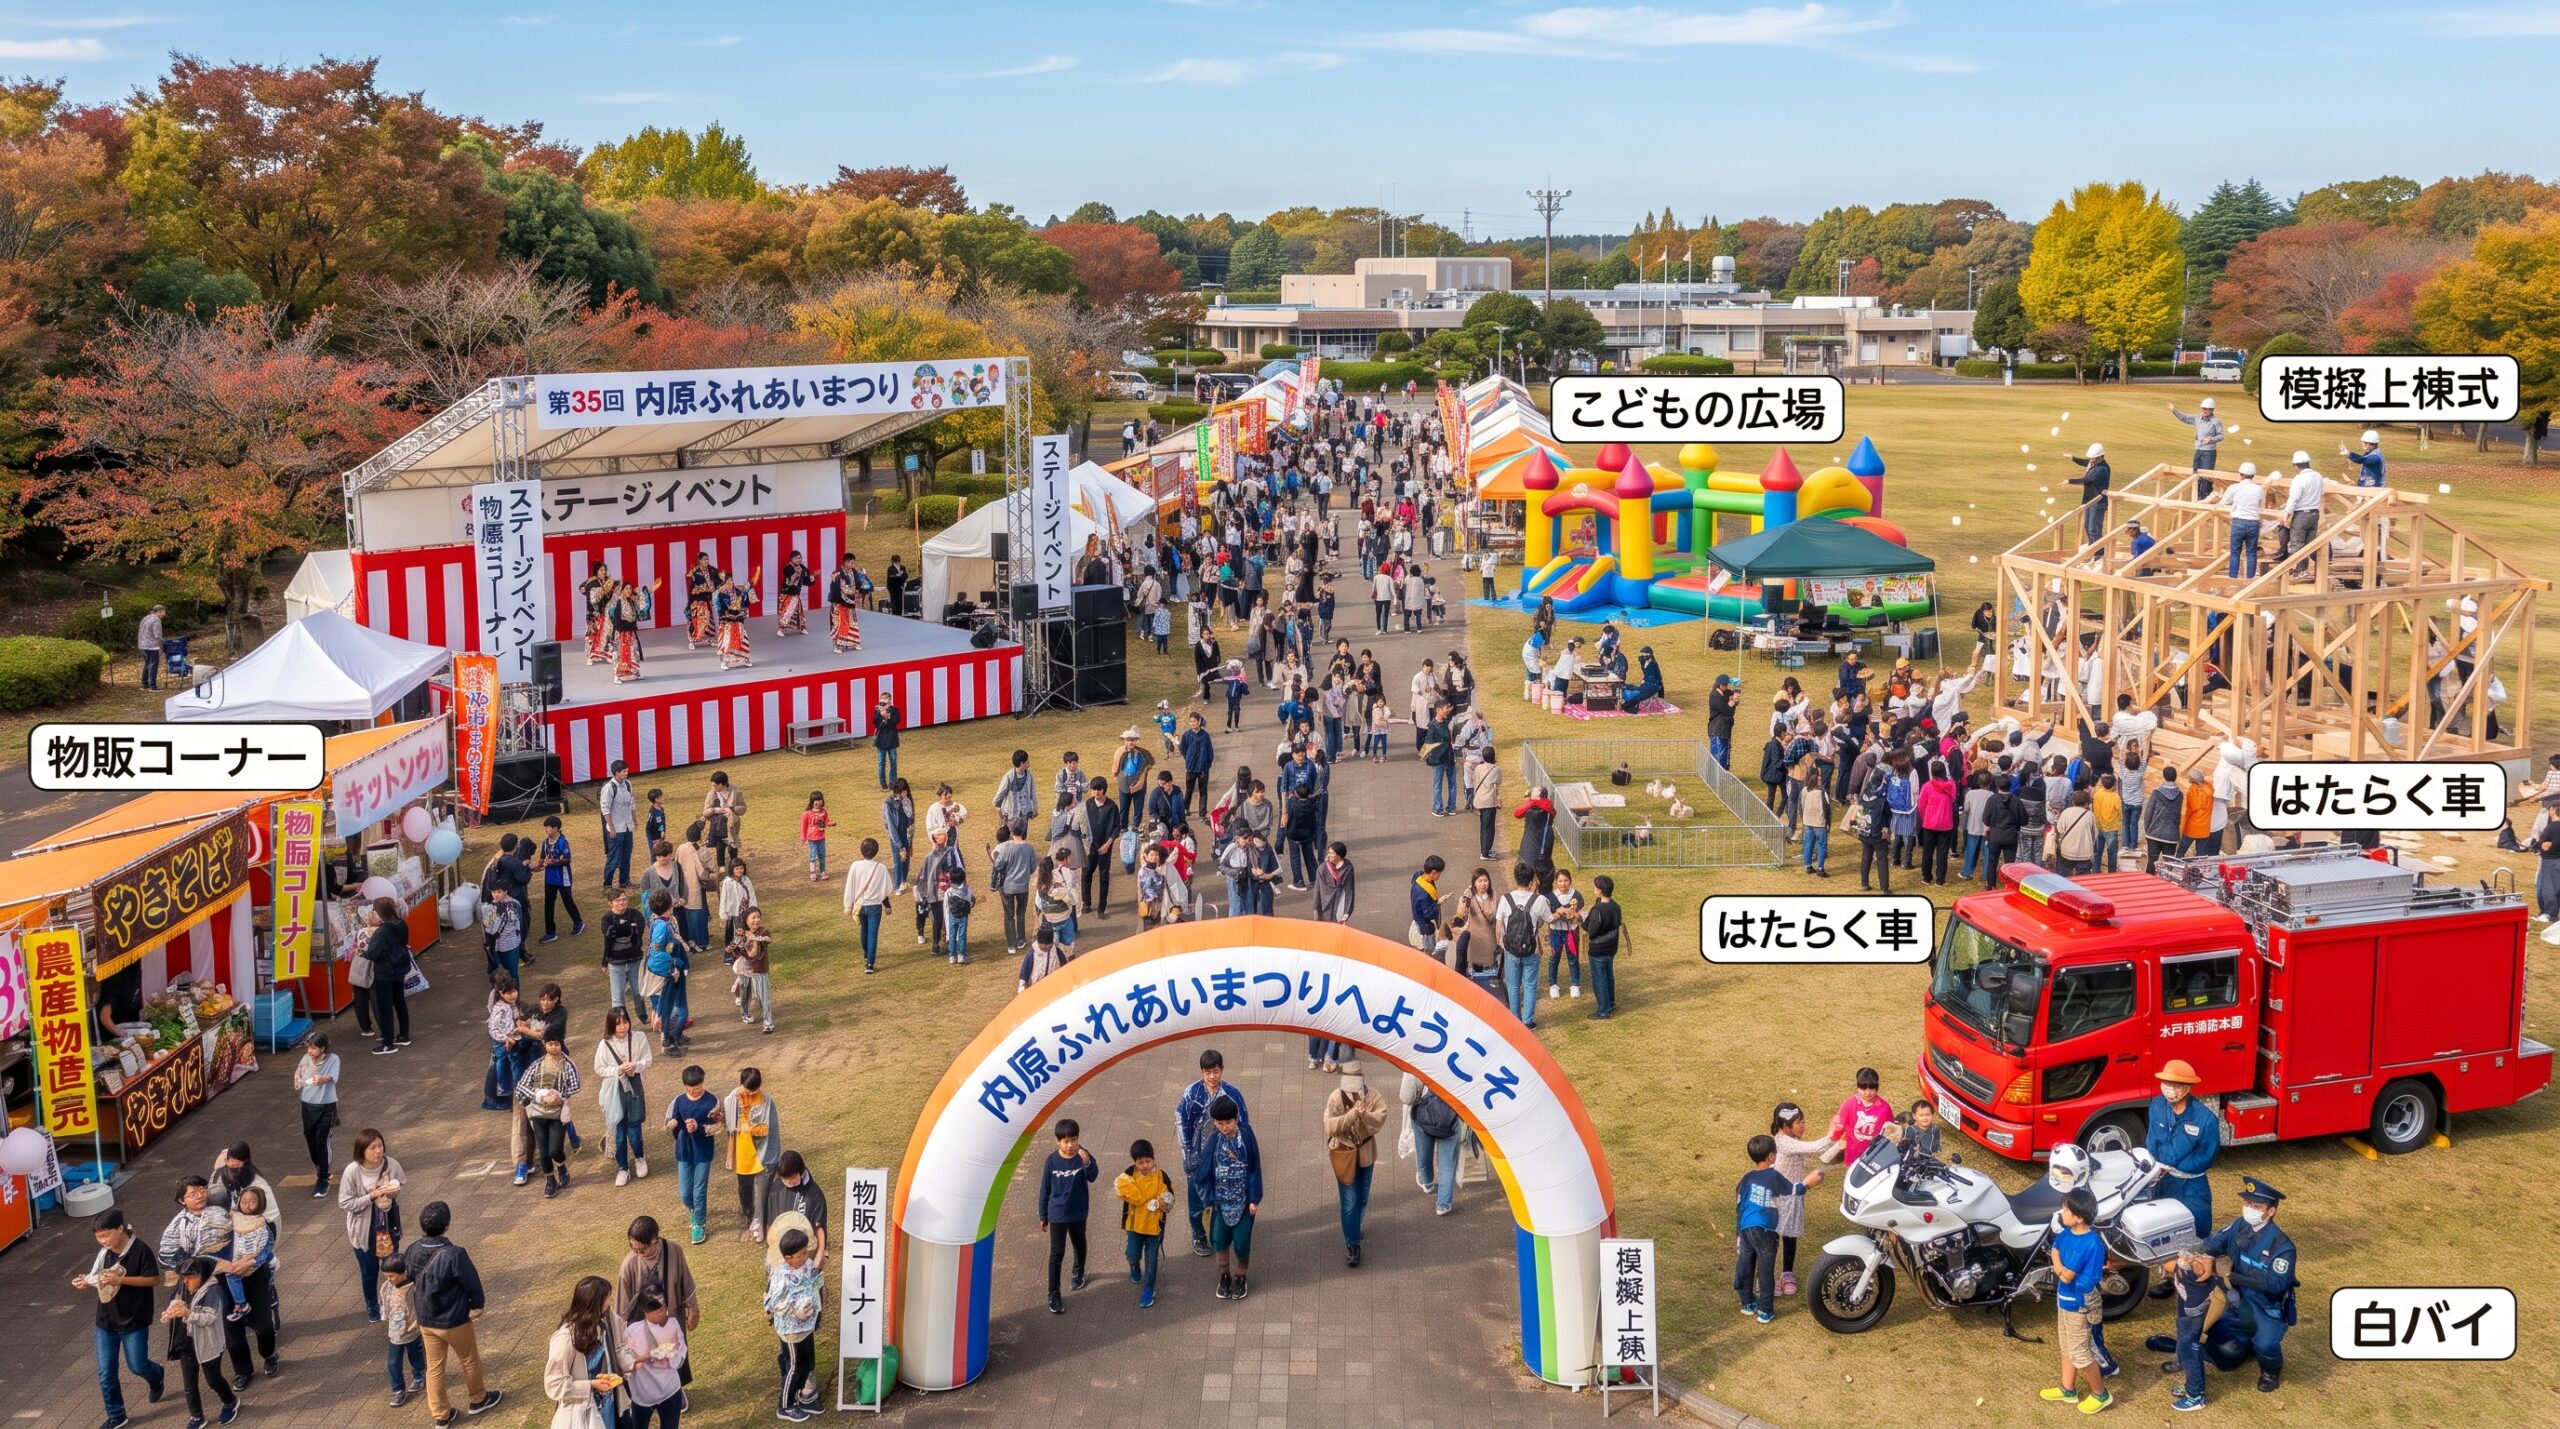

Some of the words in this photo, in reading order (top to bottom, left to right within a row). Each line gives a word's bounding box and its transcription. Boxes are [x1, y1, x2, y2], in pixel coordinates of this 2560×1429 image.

[548, 389, 625, 416] 第35回
[635, 372, 900, 416] 内原ふれあいまつり
[509, 488, 535, 672] ステージイベント
[1042, 441, 1062, 601] ステージイベント
[103, 826, 234, 949] やきそば
[979, 962, 1520, 1124] 内原ふれあいまつりへようこそ
[849, 1180, 877, 1345] 物販コーナー
